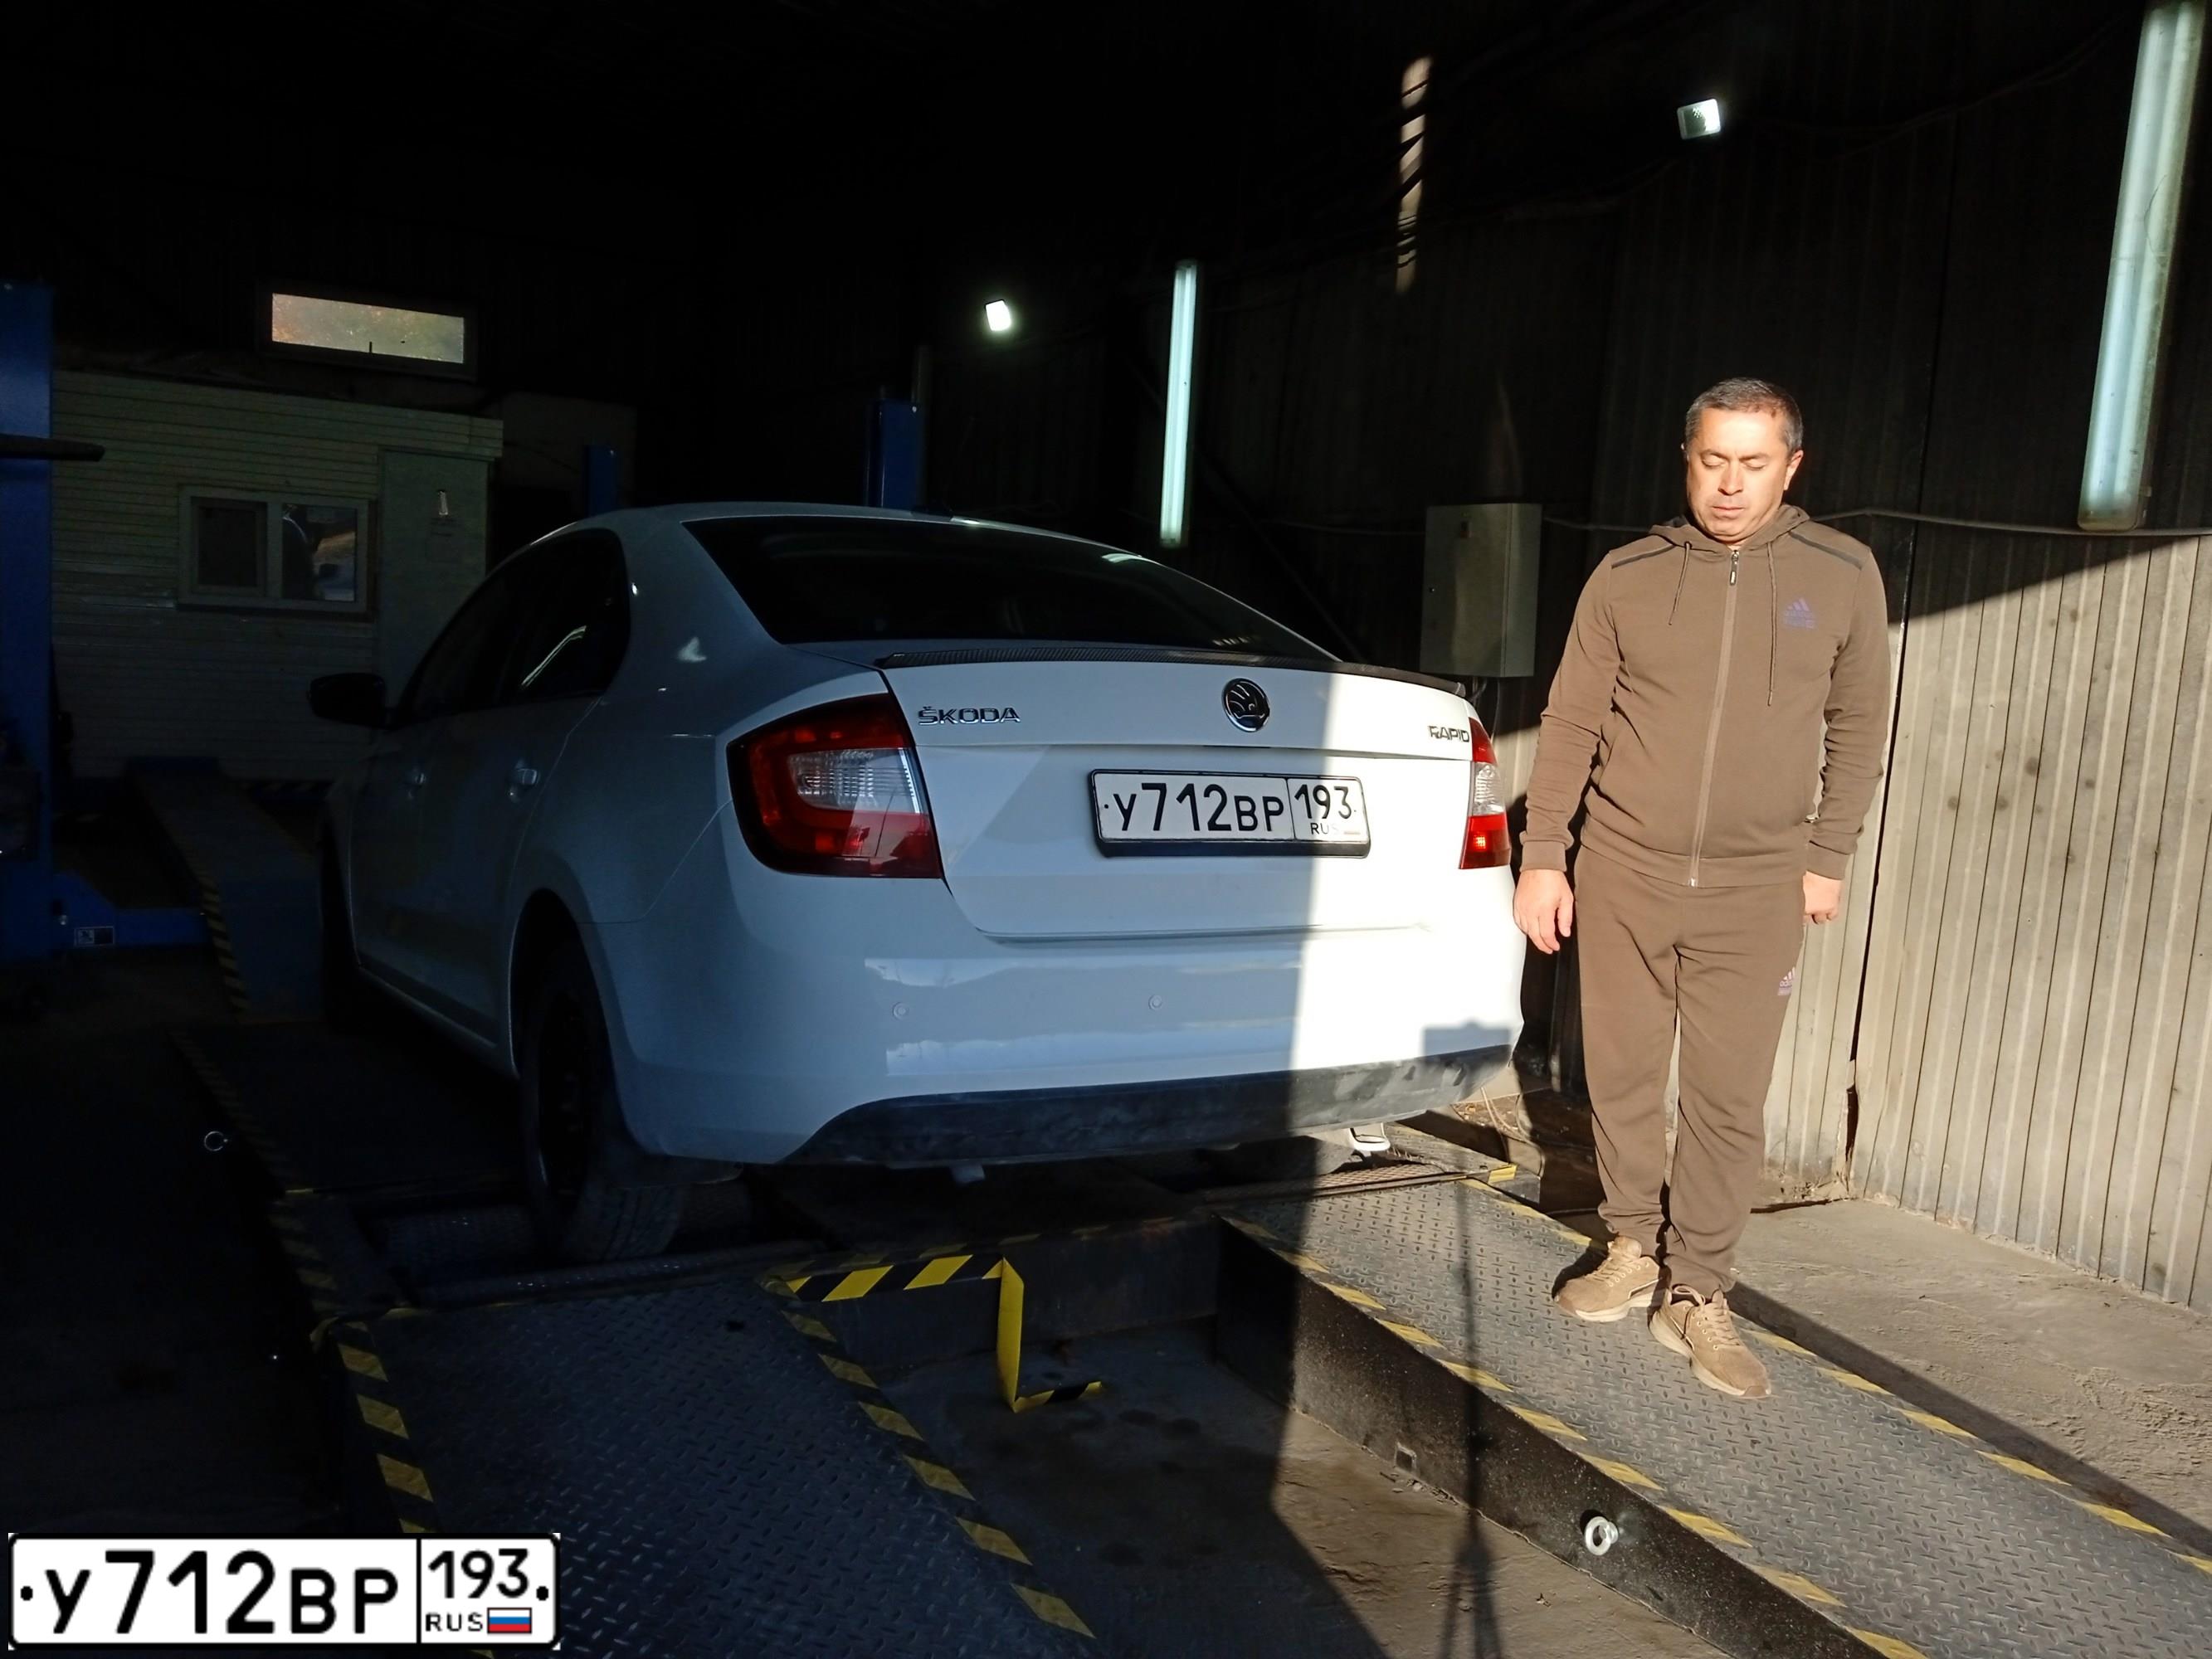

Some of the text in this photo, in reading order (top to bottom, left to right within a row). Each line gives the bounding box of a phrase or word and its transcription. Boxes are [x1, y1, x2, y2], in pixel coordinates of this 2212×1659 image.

[918, 706, 1021, 726] ŠKODA
[1427, 725, 1470, 743] RAPID
[1294, 784, 1352, 820] 193
